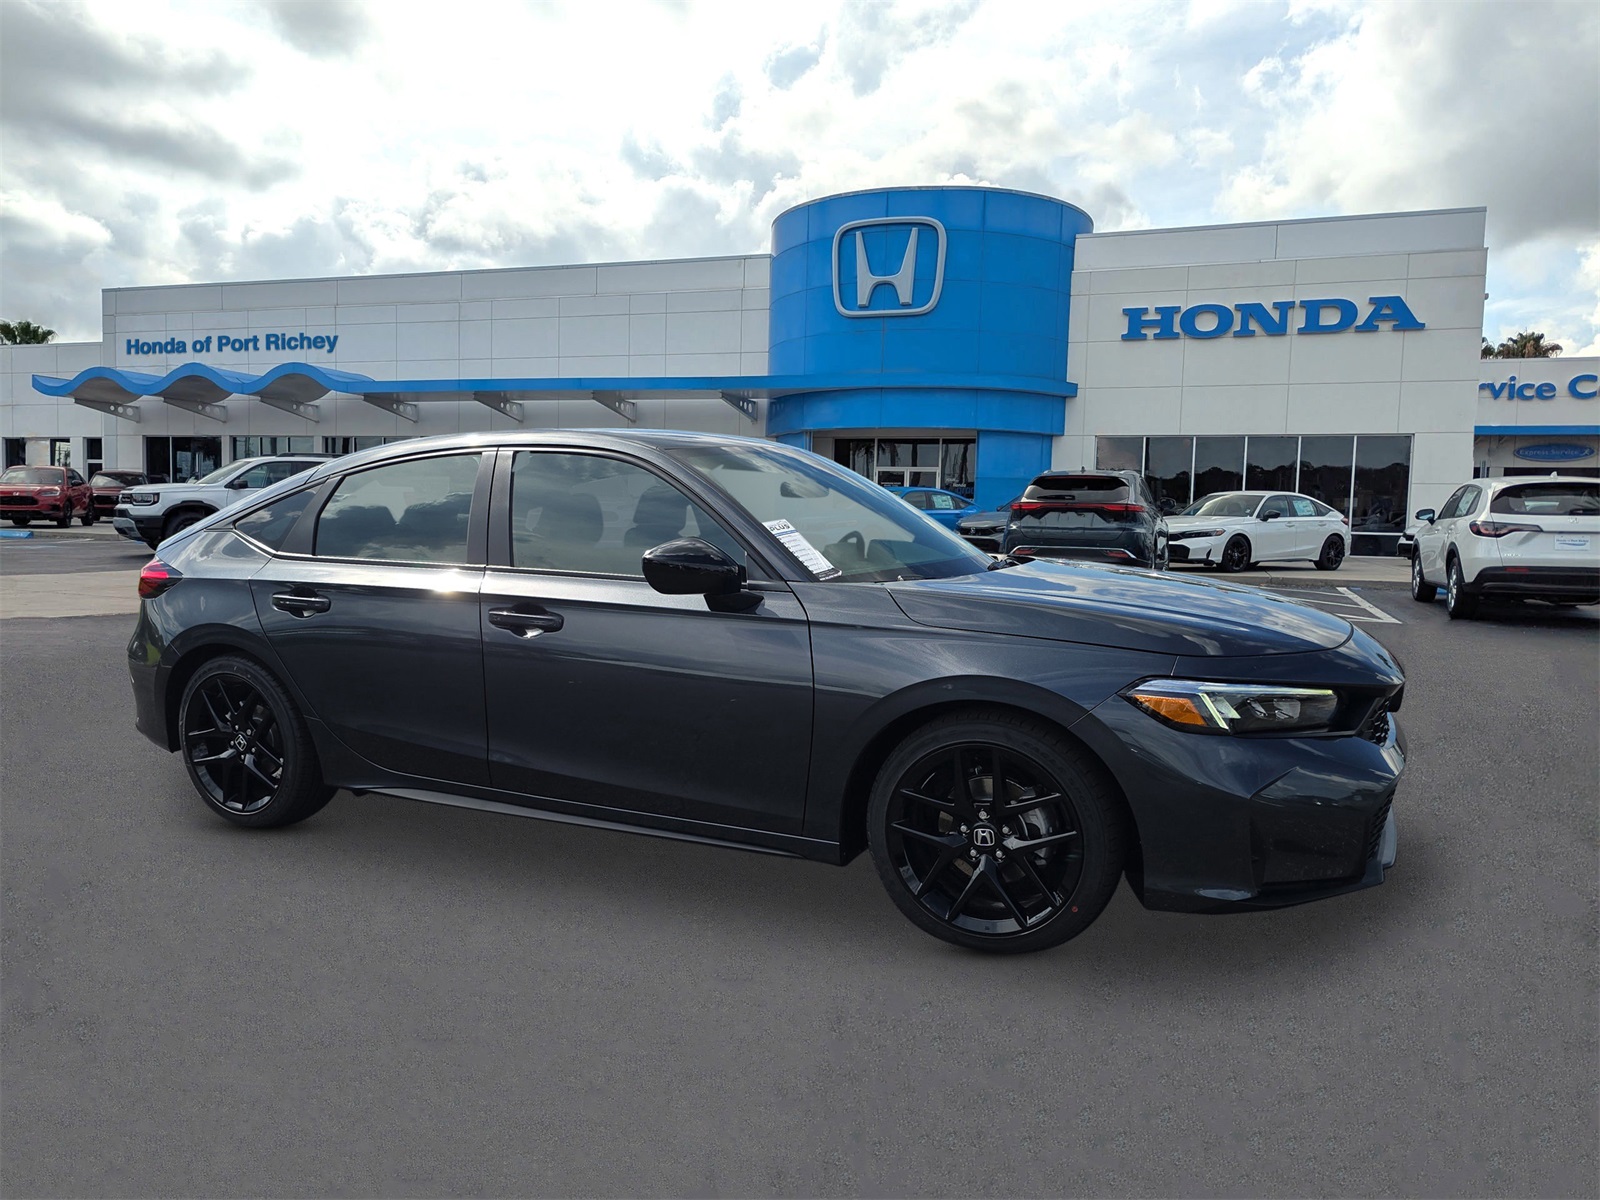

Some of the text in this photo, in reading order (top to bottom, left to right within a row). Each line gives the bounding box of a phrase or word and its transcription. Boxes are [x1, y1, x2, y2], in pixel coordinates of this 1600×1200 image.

[1121, 296, 1426, 340] HONDA
[126, 333, 339, 355] Honda of Port Richey
[769, 524, 791, 532] PLUS
